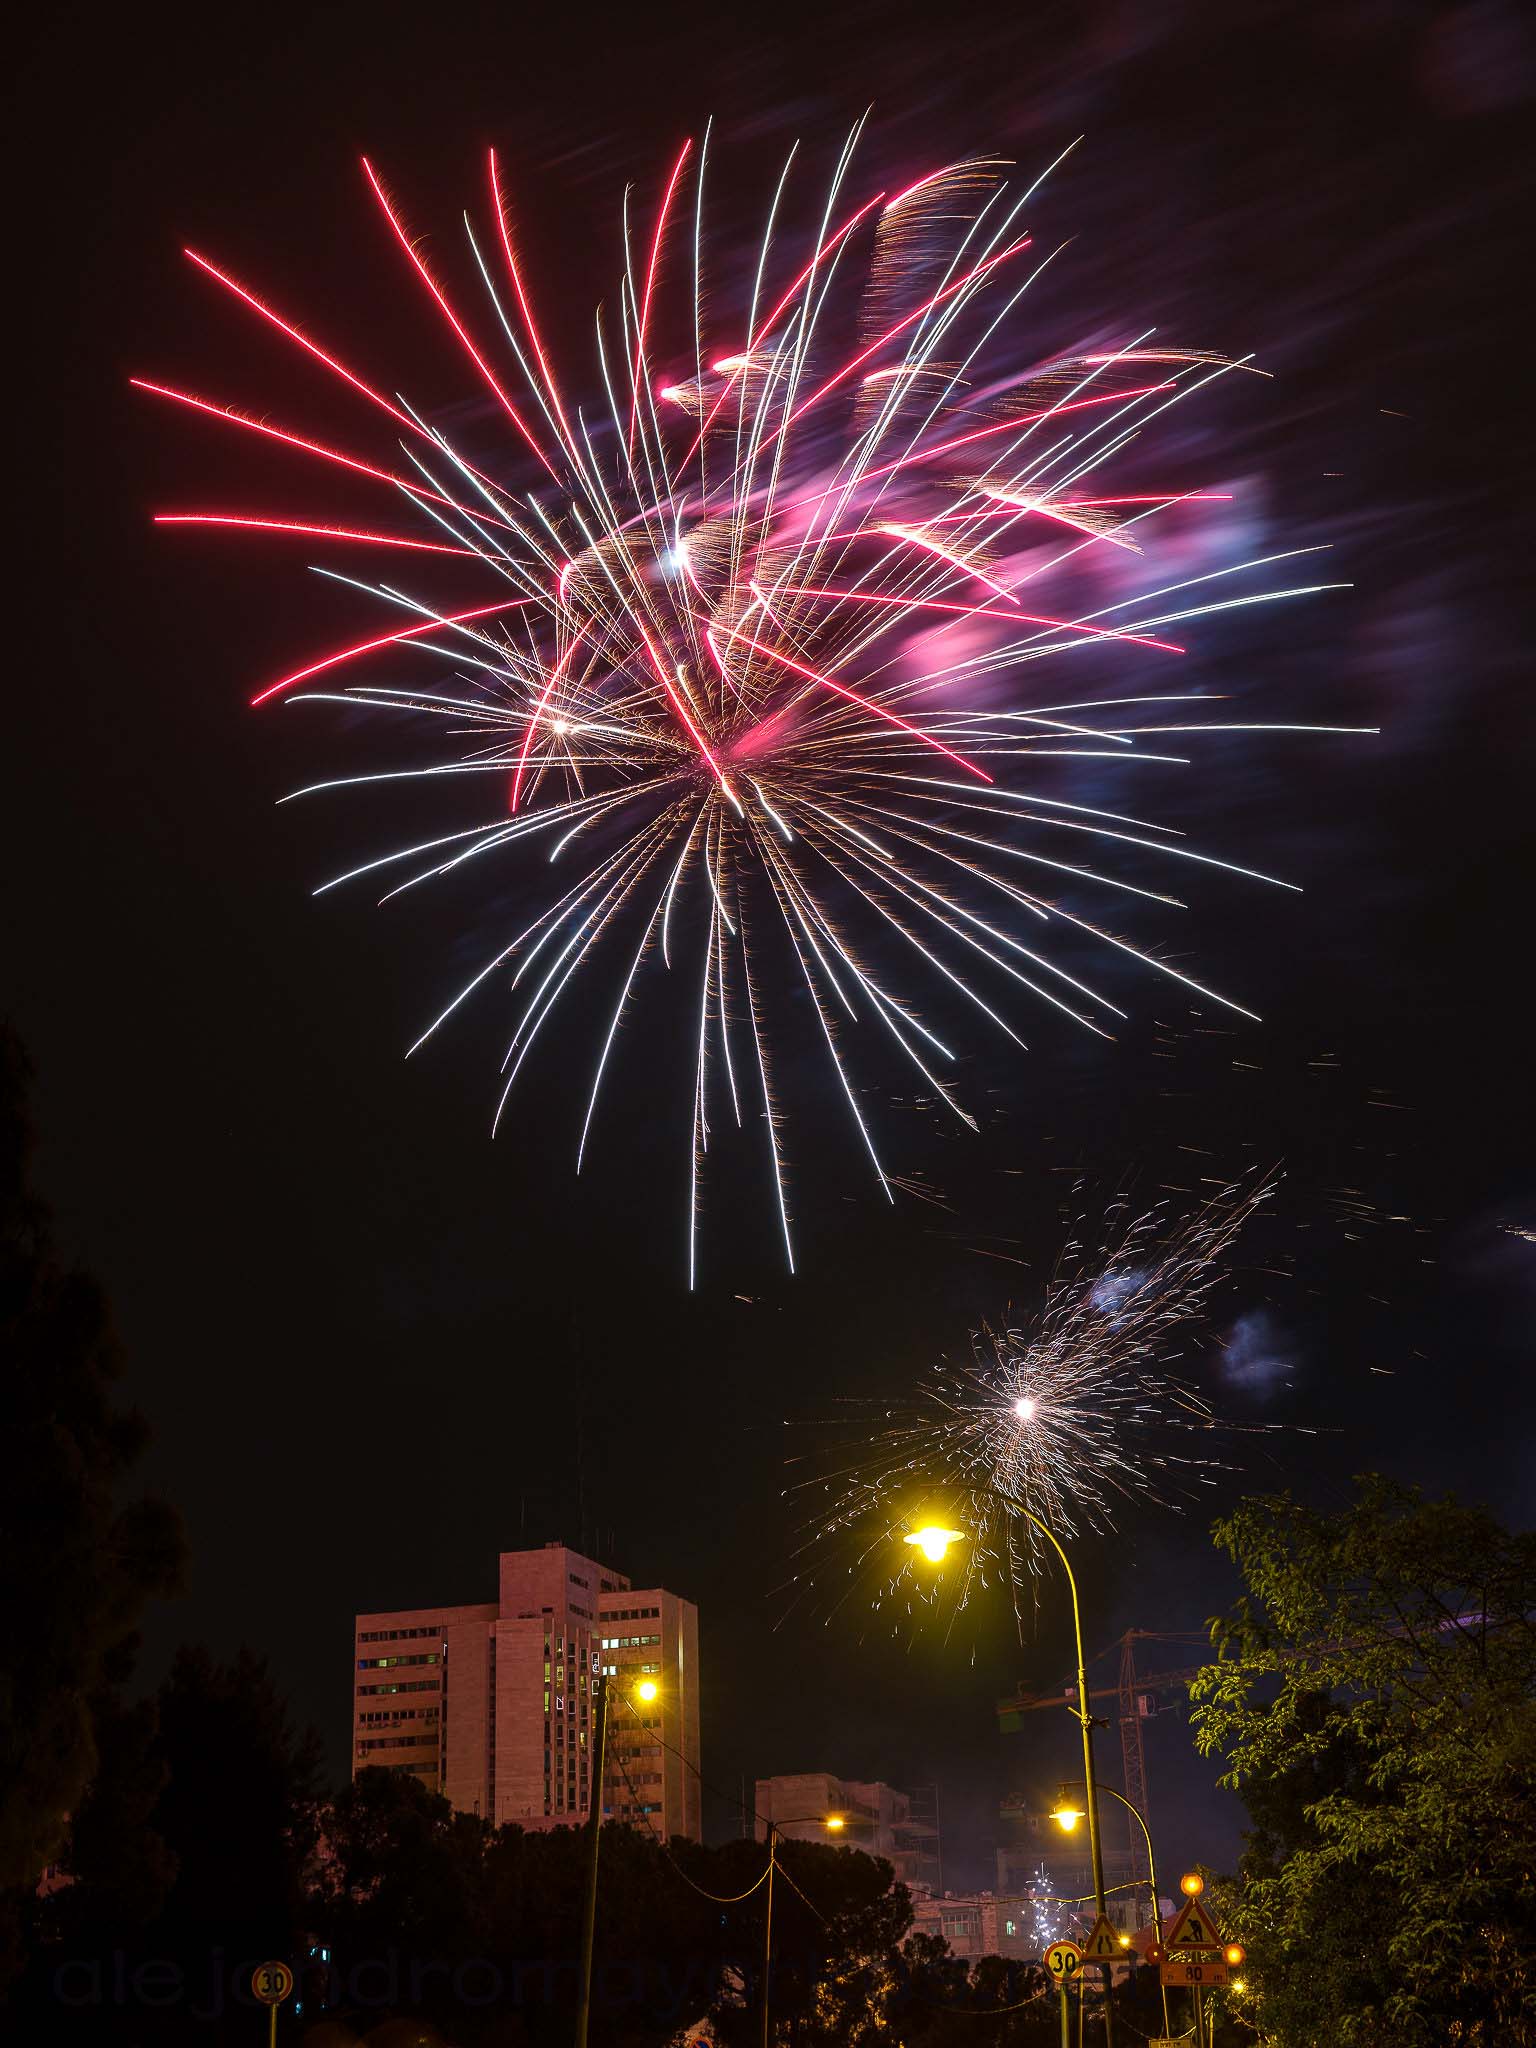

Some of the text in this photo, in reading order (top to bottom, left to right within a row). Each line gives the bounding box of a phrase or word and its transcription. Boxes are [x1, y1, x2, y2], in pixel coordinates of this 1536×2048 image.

[1053, 1951, 1075, 1972] 30
[261, 1971, 285, 1994] 30
[1185, 1966, 1202, 1981] 80
